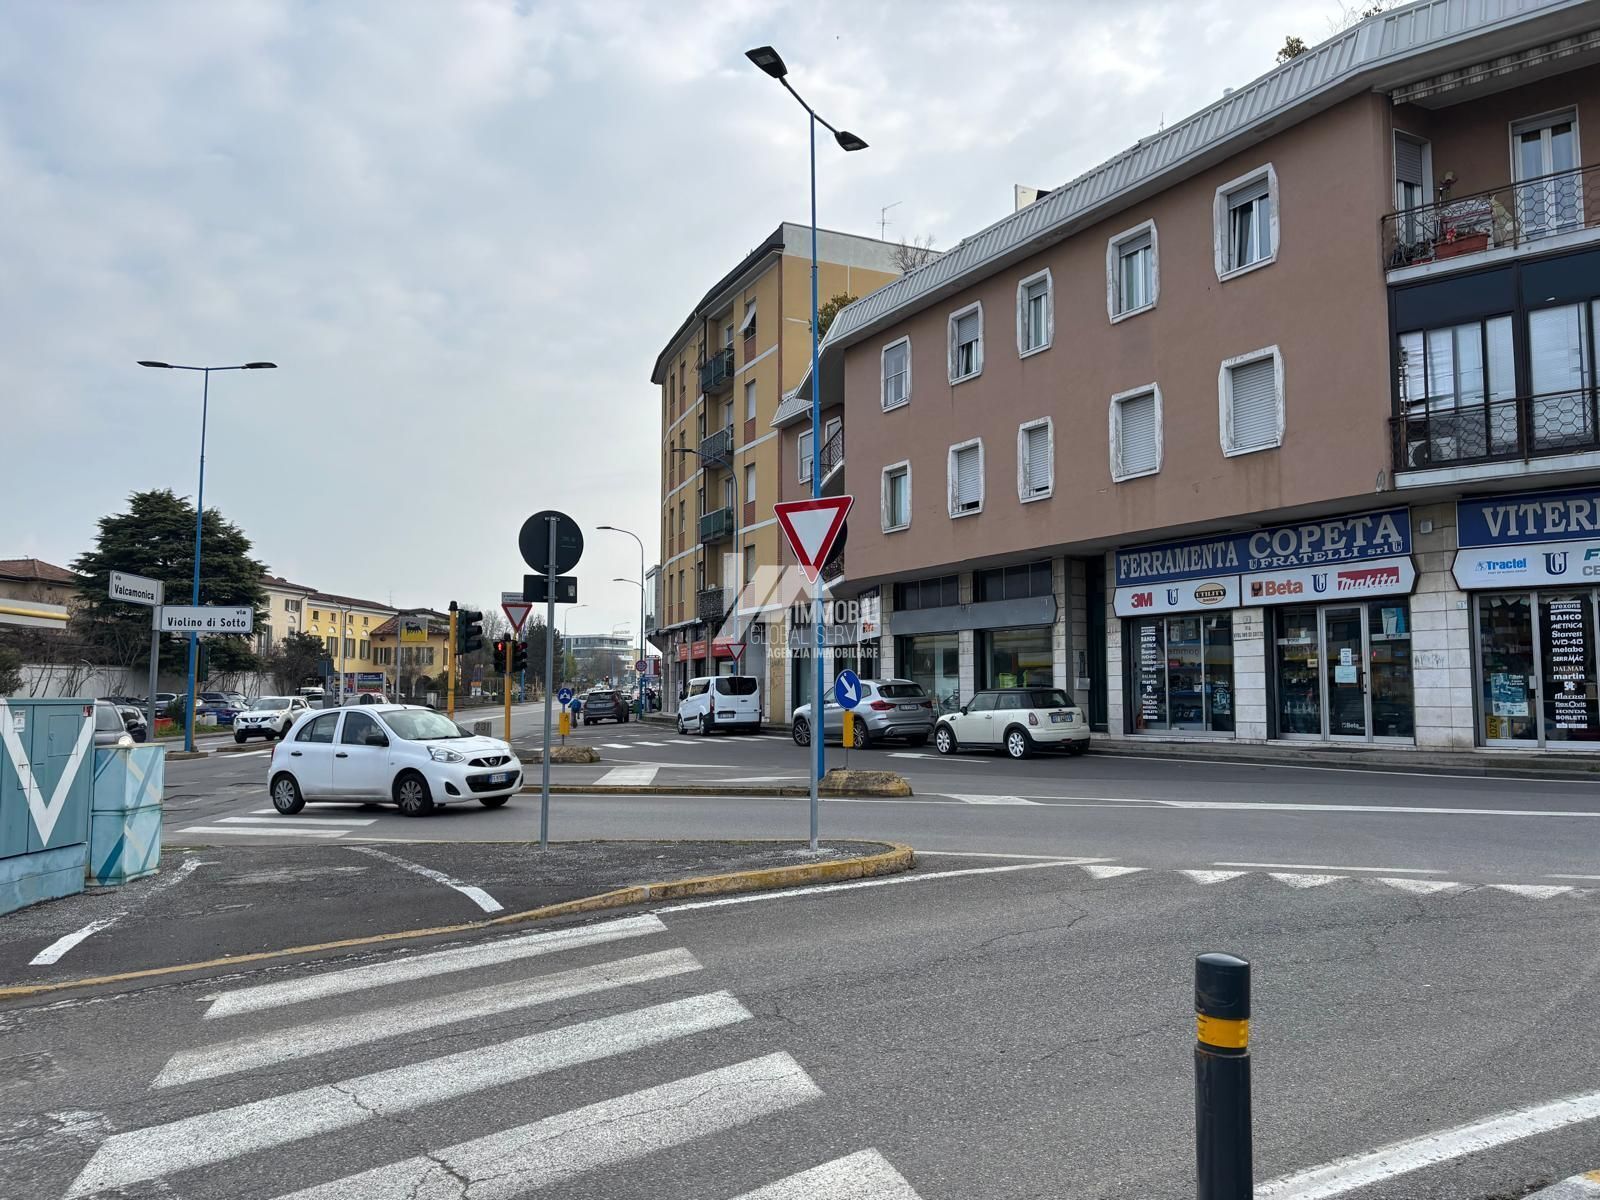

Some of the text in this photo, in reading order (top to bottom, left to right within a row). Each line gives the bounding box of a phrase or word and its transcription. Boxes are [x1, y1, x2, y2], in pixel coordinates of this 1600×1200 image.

[1249, 514, 1403, 559] COPETA
[1120, 541, 1239, 579] FERRAMENTA
[1260, 547, 1360, 568] FRATELLI
[1367, 545, 1388, 556] srl
[1487, 558, 1527, 570] Tractel
[114, 583, 155, 600] Valcamonica
[1266, 580, 1304, 596] Beta
[1131, 592, 1153, 608] 3M
[167, 617, 246, 628] Violino di Sotto
[1553, 672, 1585, 680] martin
